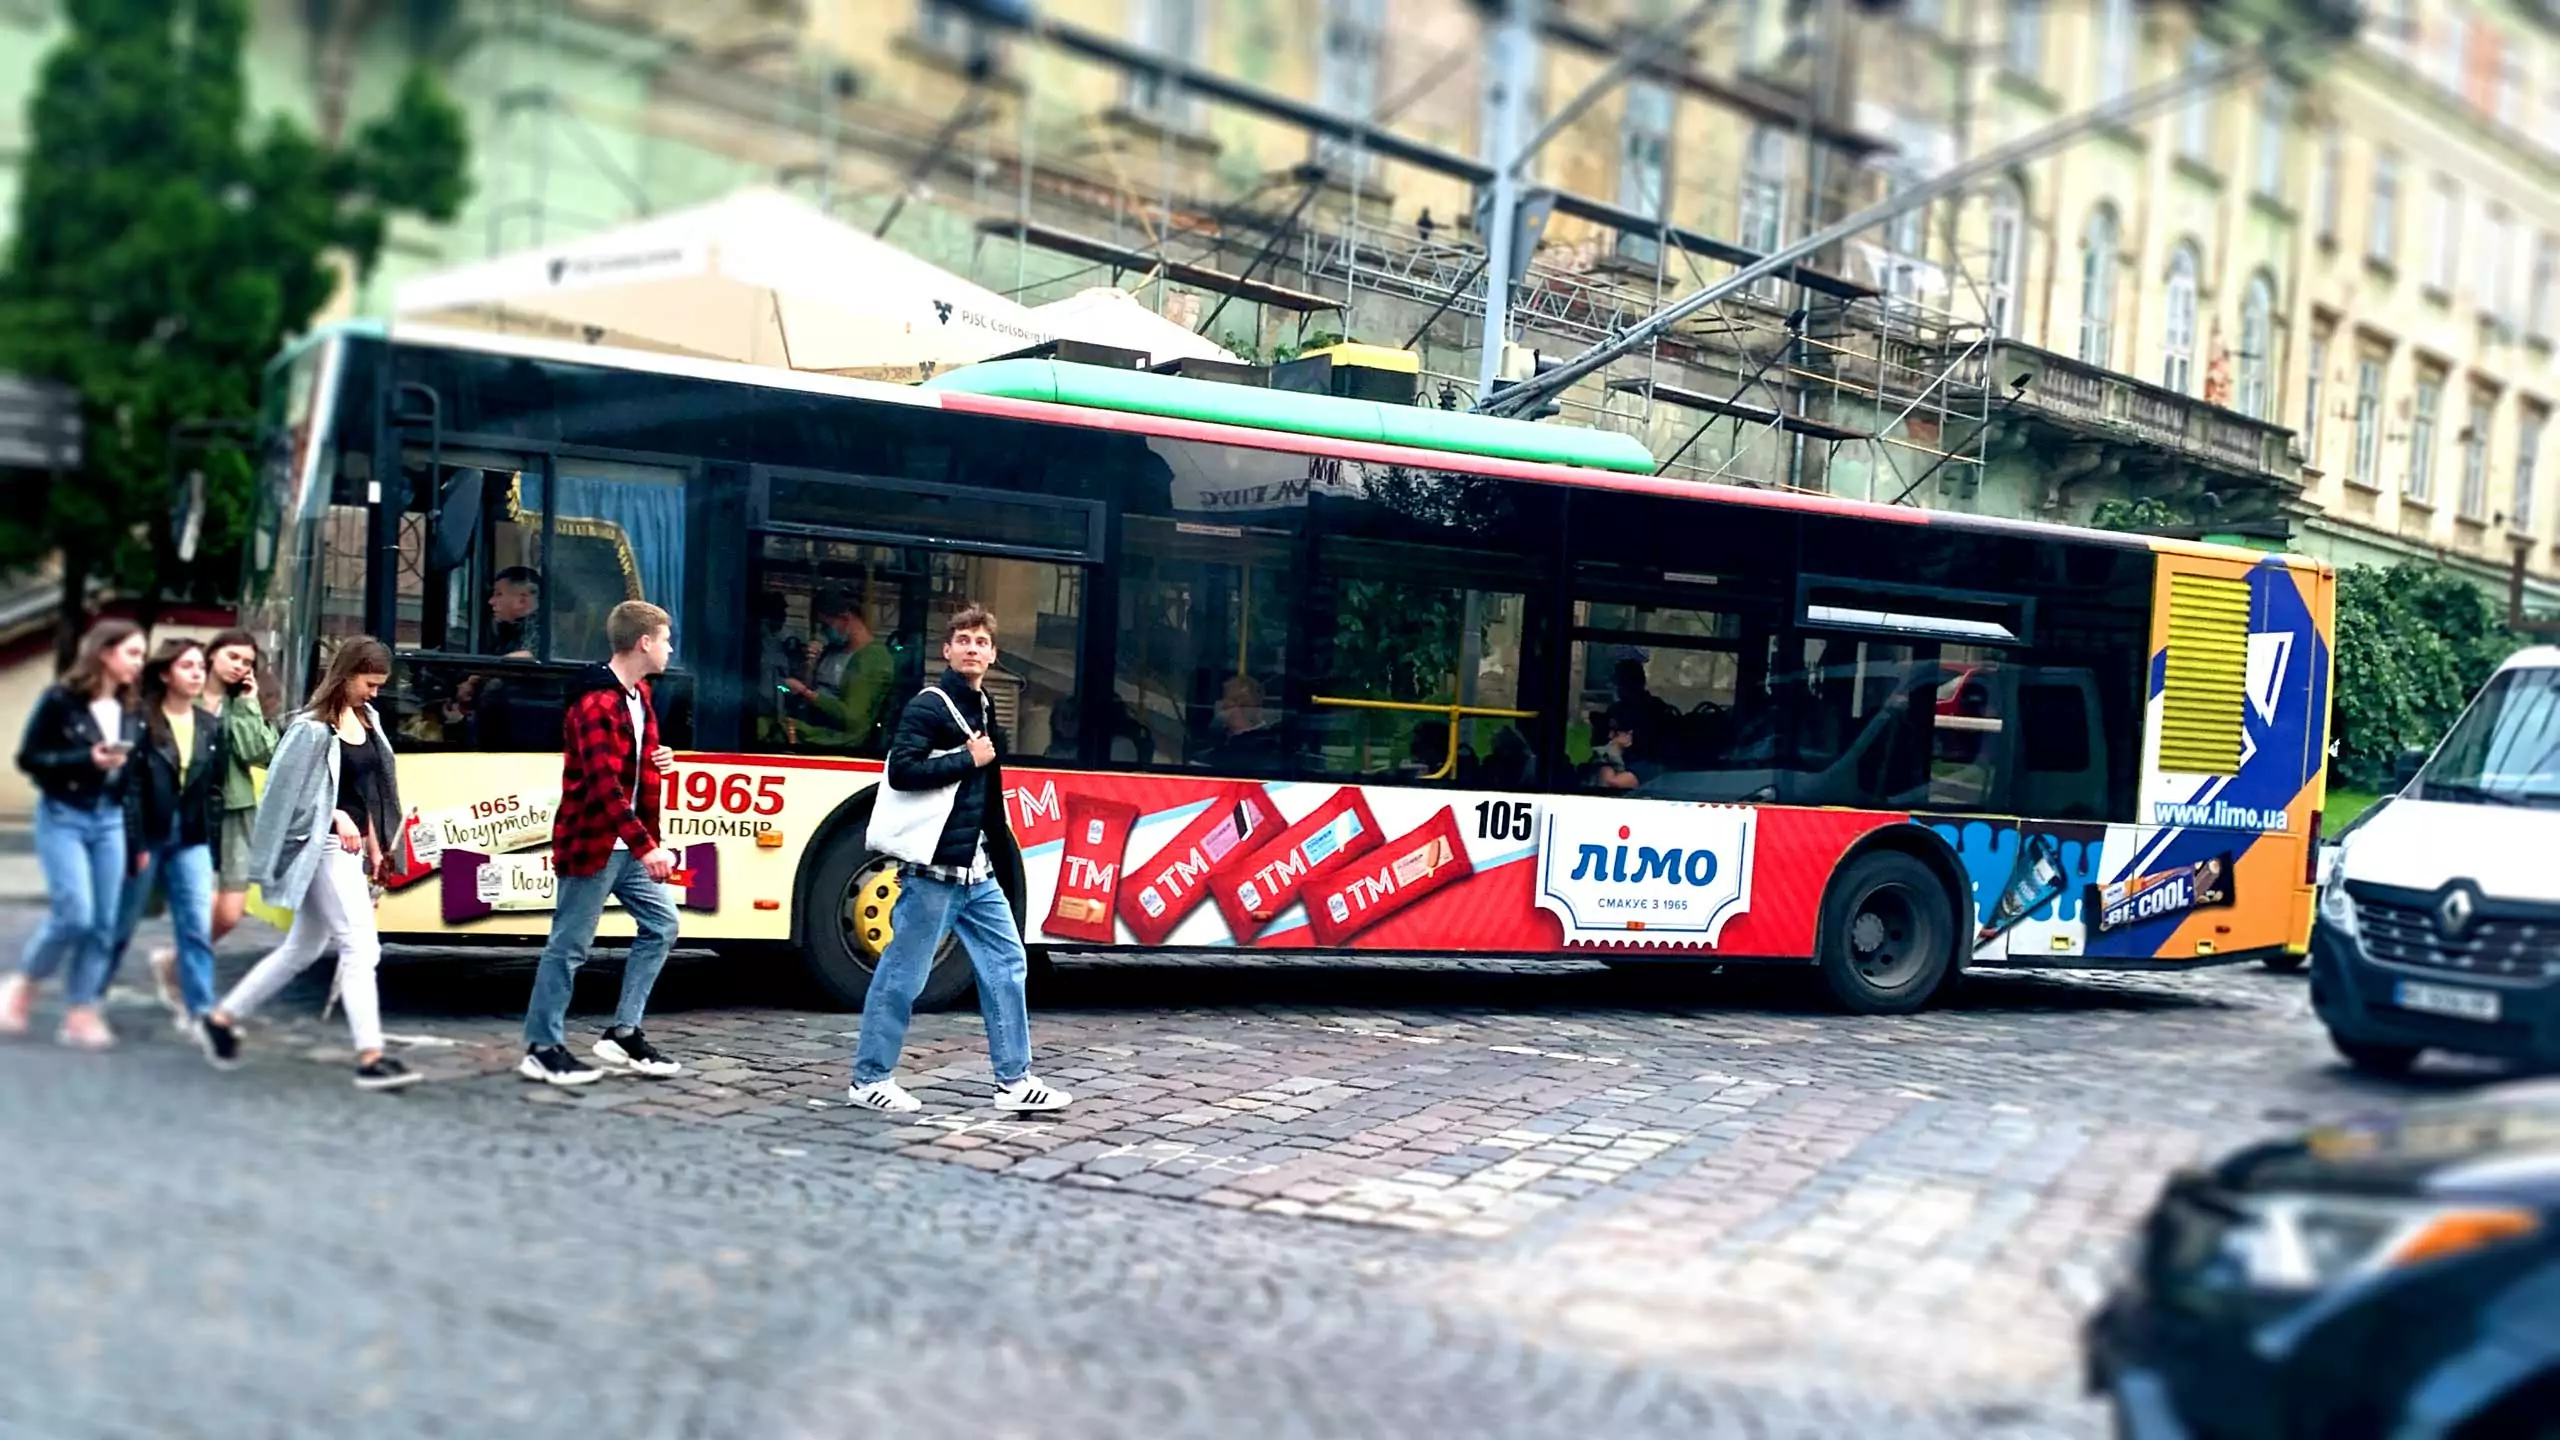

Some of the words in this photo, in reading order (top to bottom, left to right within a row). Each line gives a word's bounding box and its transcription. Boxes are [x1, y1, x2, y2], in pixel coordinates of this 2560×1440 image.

[962, 310, 987, 329] PJSC
[990, 318, 1040, 343] Carlsberg
[470, 794, 520, 820] 1965
[660, 770, 786, 816] 1965
[443, 804, 551, 848] Йогуртове
[1475, 800, 1532, 841] 105
[2155, 799, 2288, 829] www.limo.ua
[1597, 898, 1648, 909] СМАКУЄ
[1663, 899, 1688, 910] 1965
[2138, 877, 2189, 917] COOL
